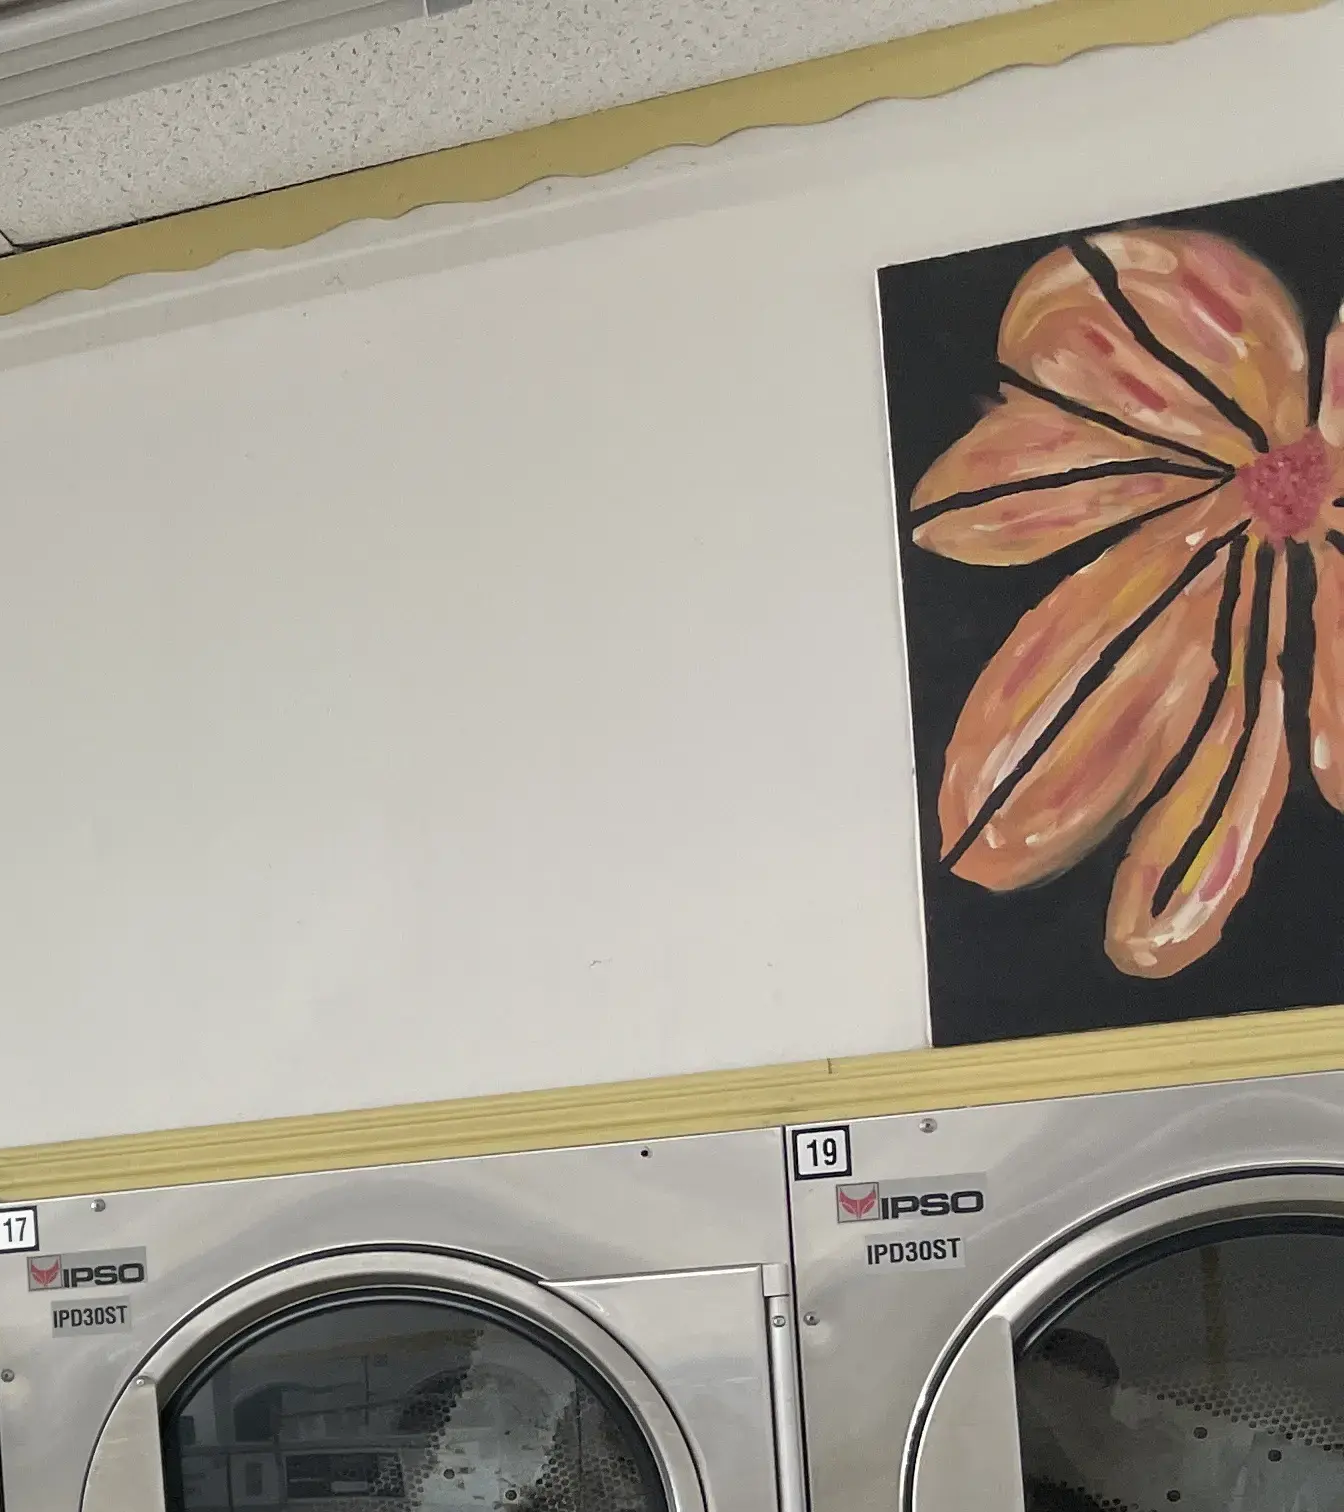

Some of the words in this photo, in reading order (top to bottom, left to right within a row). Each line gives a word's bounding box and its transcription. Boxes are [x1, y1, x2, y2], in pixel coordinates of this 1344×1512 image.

[806, 1137, 838, 1167] 19
[881, 1190, 984, 1220] IPSO
[2, 1217, 27, 1243] 17
[867, 1237, 961, 1266] IPD30ST
[62, 1262, 145, 1288] IPSO
[53, 1305, 128, 1329] IPD30ST
